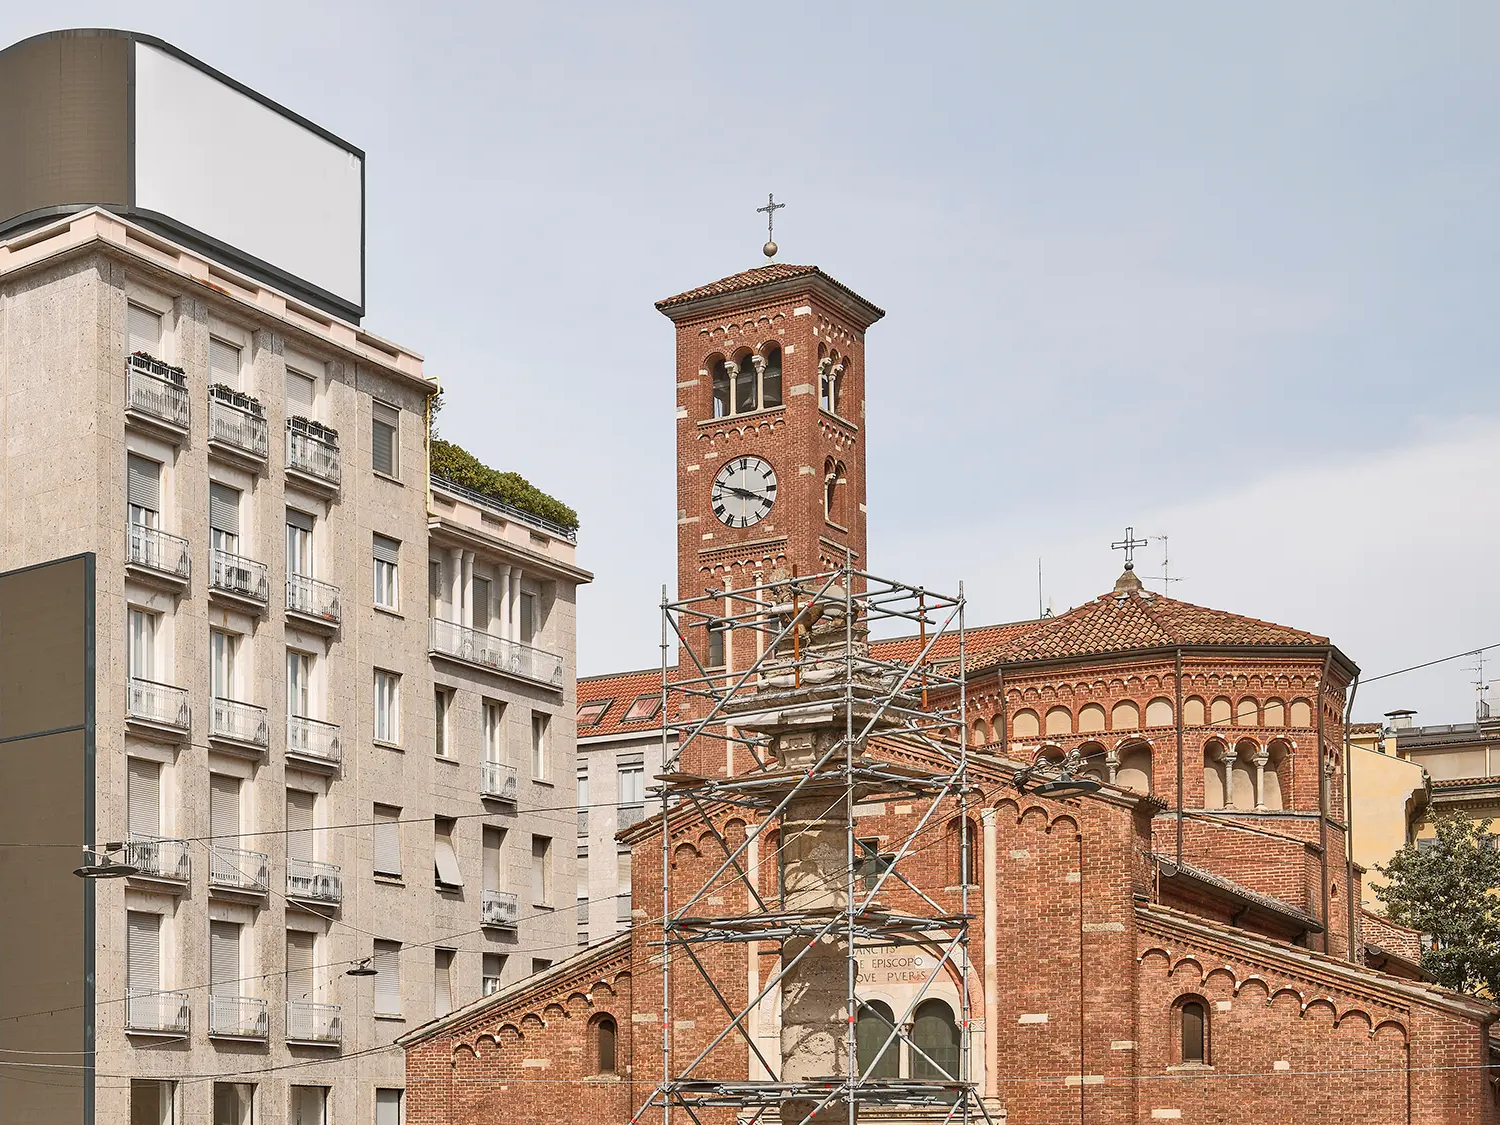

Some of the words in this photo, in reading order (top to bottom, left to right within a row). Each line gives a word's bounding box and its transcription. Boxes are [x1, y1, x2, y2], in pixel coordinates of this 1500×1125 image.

[853, 946, 896, 955] ANCTIS
[871, 957, 923, 969] EPISCOPO
[887, 971, 927, 982] PVERIS
